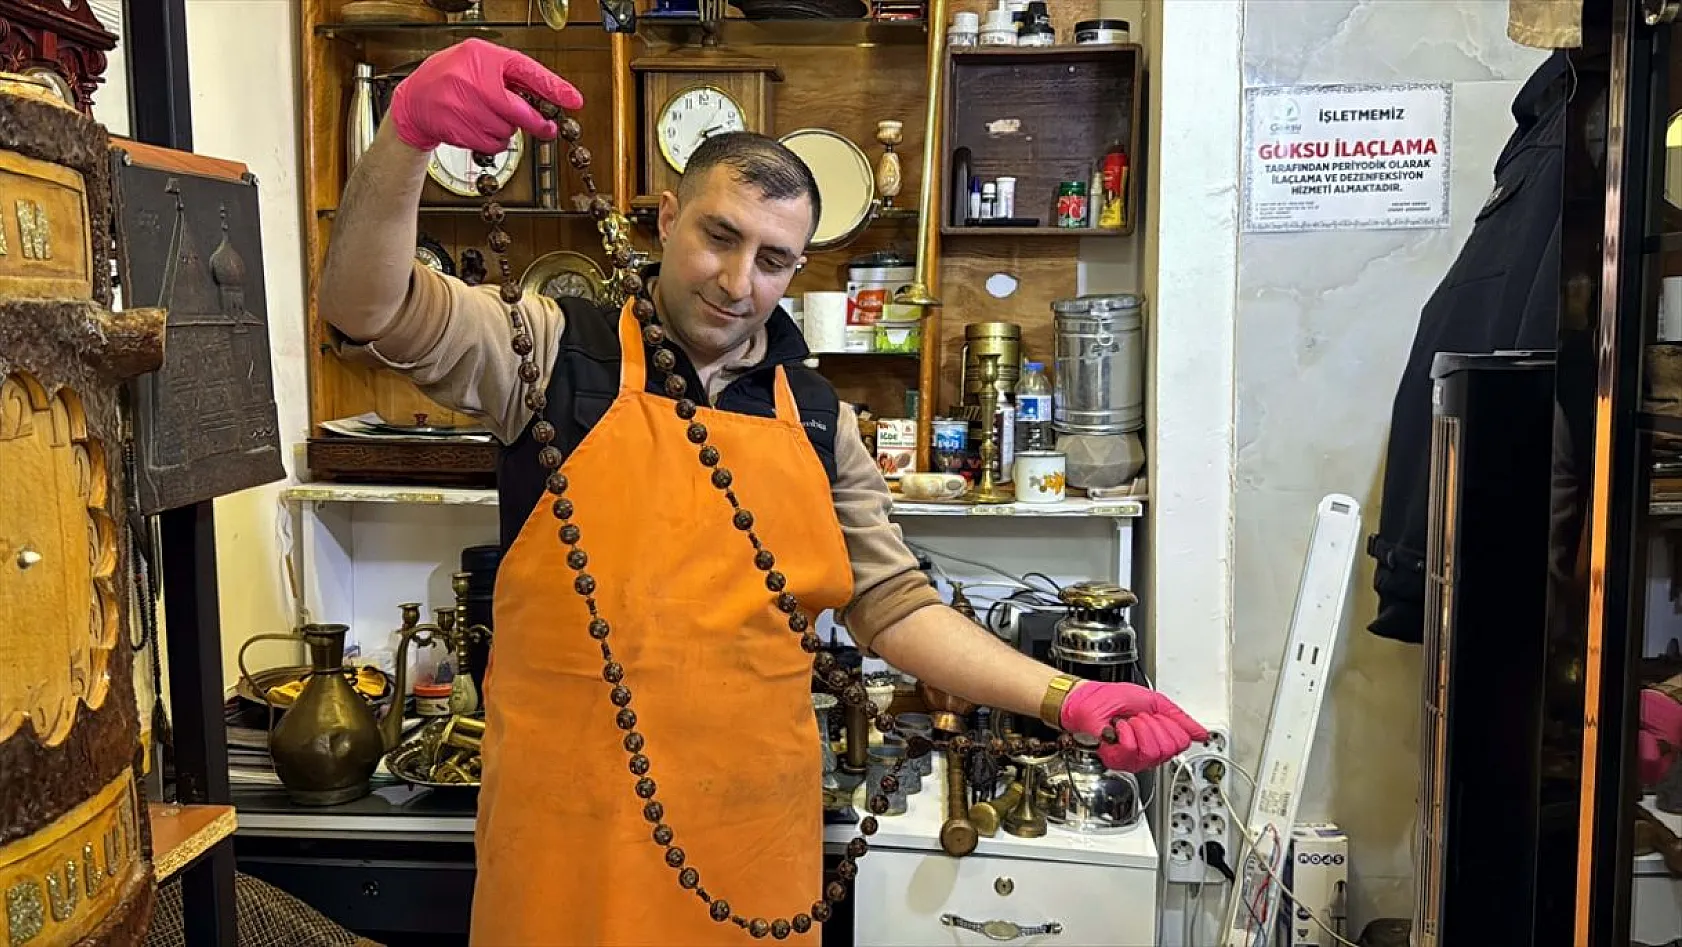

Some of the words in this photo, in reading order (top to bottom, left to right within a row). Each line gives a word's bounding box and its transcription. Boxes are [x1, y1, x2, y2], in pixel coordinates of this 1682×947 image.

[1319, 107, 1404, 123] İŞLETMEMİZ
[1258, 141, 1329, 160] GÖKSU
[1335, 139, 1437, 159] İLAÇLAMA
[1265, 163, 1330, 173] TARAFINDAN
[1332, 160, 1387, 171] PERİYODİK
[1389, 159, 1432, 169] OLARAK
[1271, 173, 1323, 185] İLAÇLAMA
[1325, 173, 1338, 183] VE
[1339, 170, 1424, 182] DEZENFEKSİYON
[1291, 183, 1332, 195] HİZMETİ
[1333, 182, 1403, 194] ALMAKTADIR.
